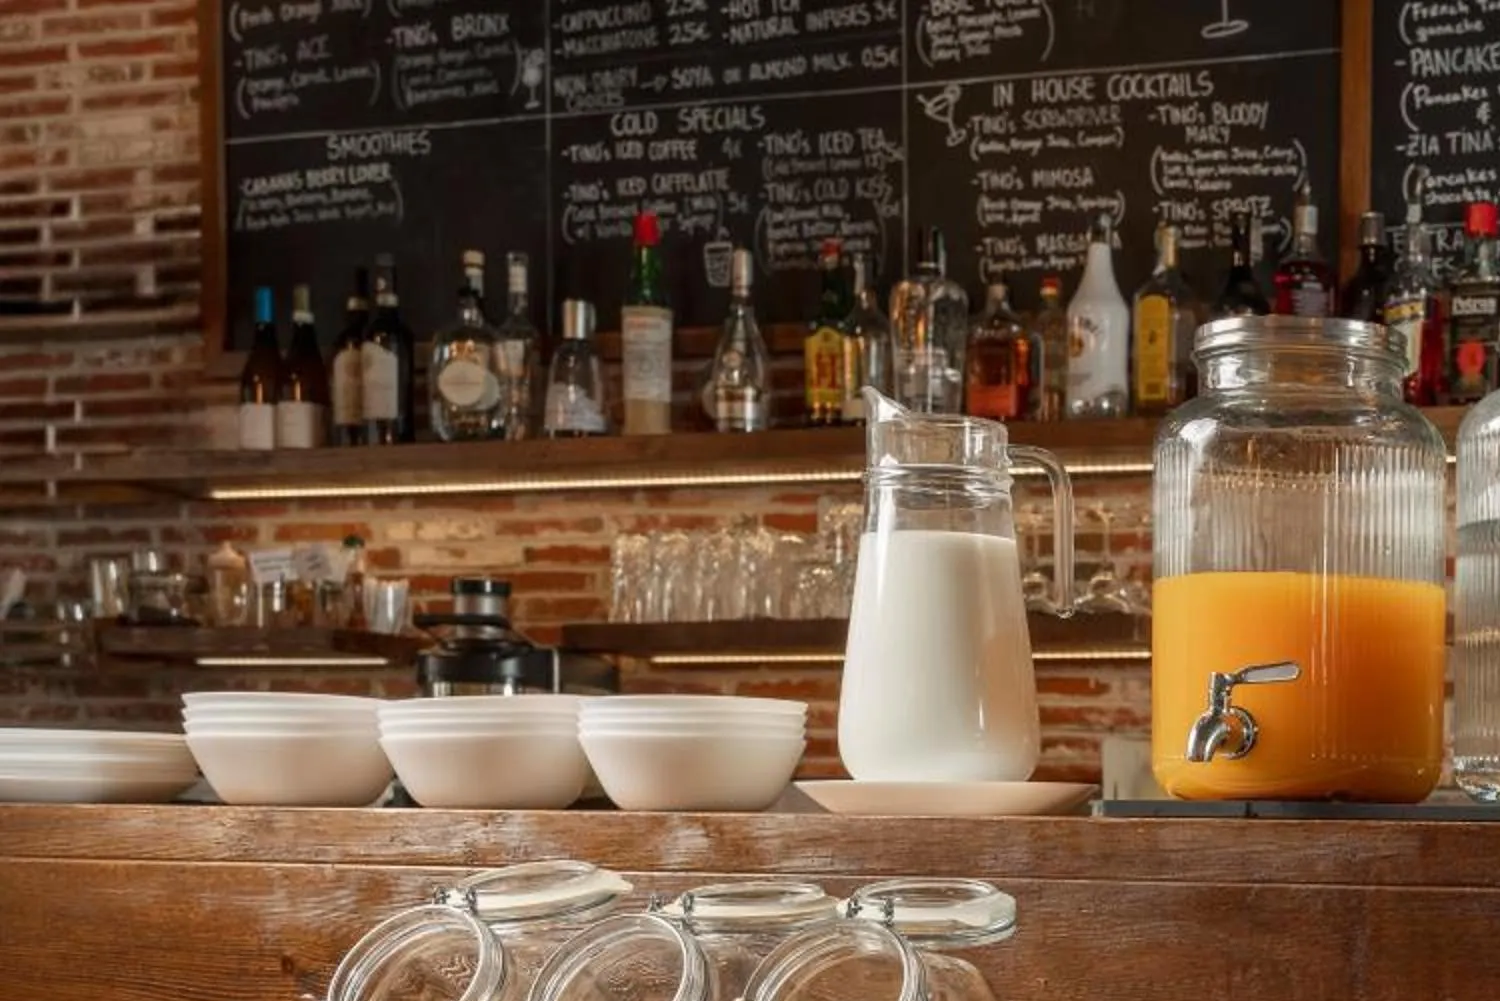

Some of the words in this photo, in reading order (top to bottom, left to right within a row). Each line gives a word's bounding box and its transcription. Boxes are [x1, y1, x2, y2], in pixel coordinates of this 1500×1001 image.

[992, 82, 1015, 108] IN
[1032, 76, 1097, 103] HOUSE
[1107, 71, 1214, 101] COCKTAILS
[610, 112, 659, 136] COLD
[677, 105, 766, 134] SPECIALS
[1211, 101, 1270, 130] BLOODY
[326, 131, 432, 160] SMOOTHIES
[1185, 125, 1231, 145] MARY
[1406, 134, 1440, 156] ZIA
[1032, 165, 1097, 190] MIMOSA
